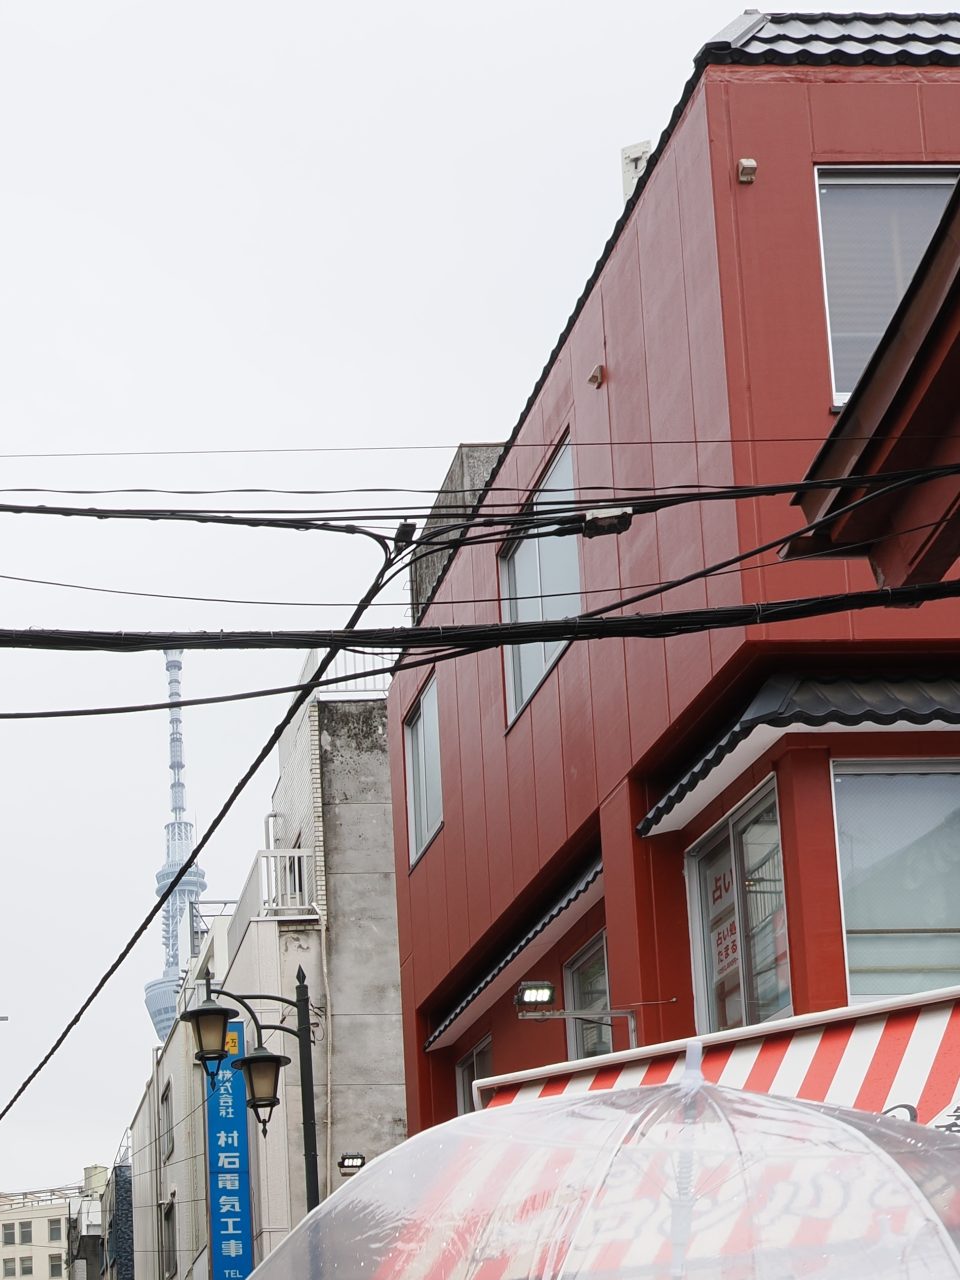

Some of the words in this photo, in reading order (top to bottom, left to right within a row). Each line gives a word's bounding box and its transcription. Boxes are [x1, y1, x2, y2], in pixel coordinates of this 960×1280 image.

[218, 1070, 235, 1118] 株式会社
[216, 1130, 243, 1258] 村石電気工事
[224, 1270, 243, 1278] TEL
